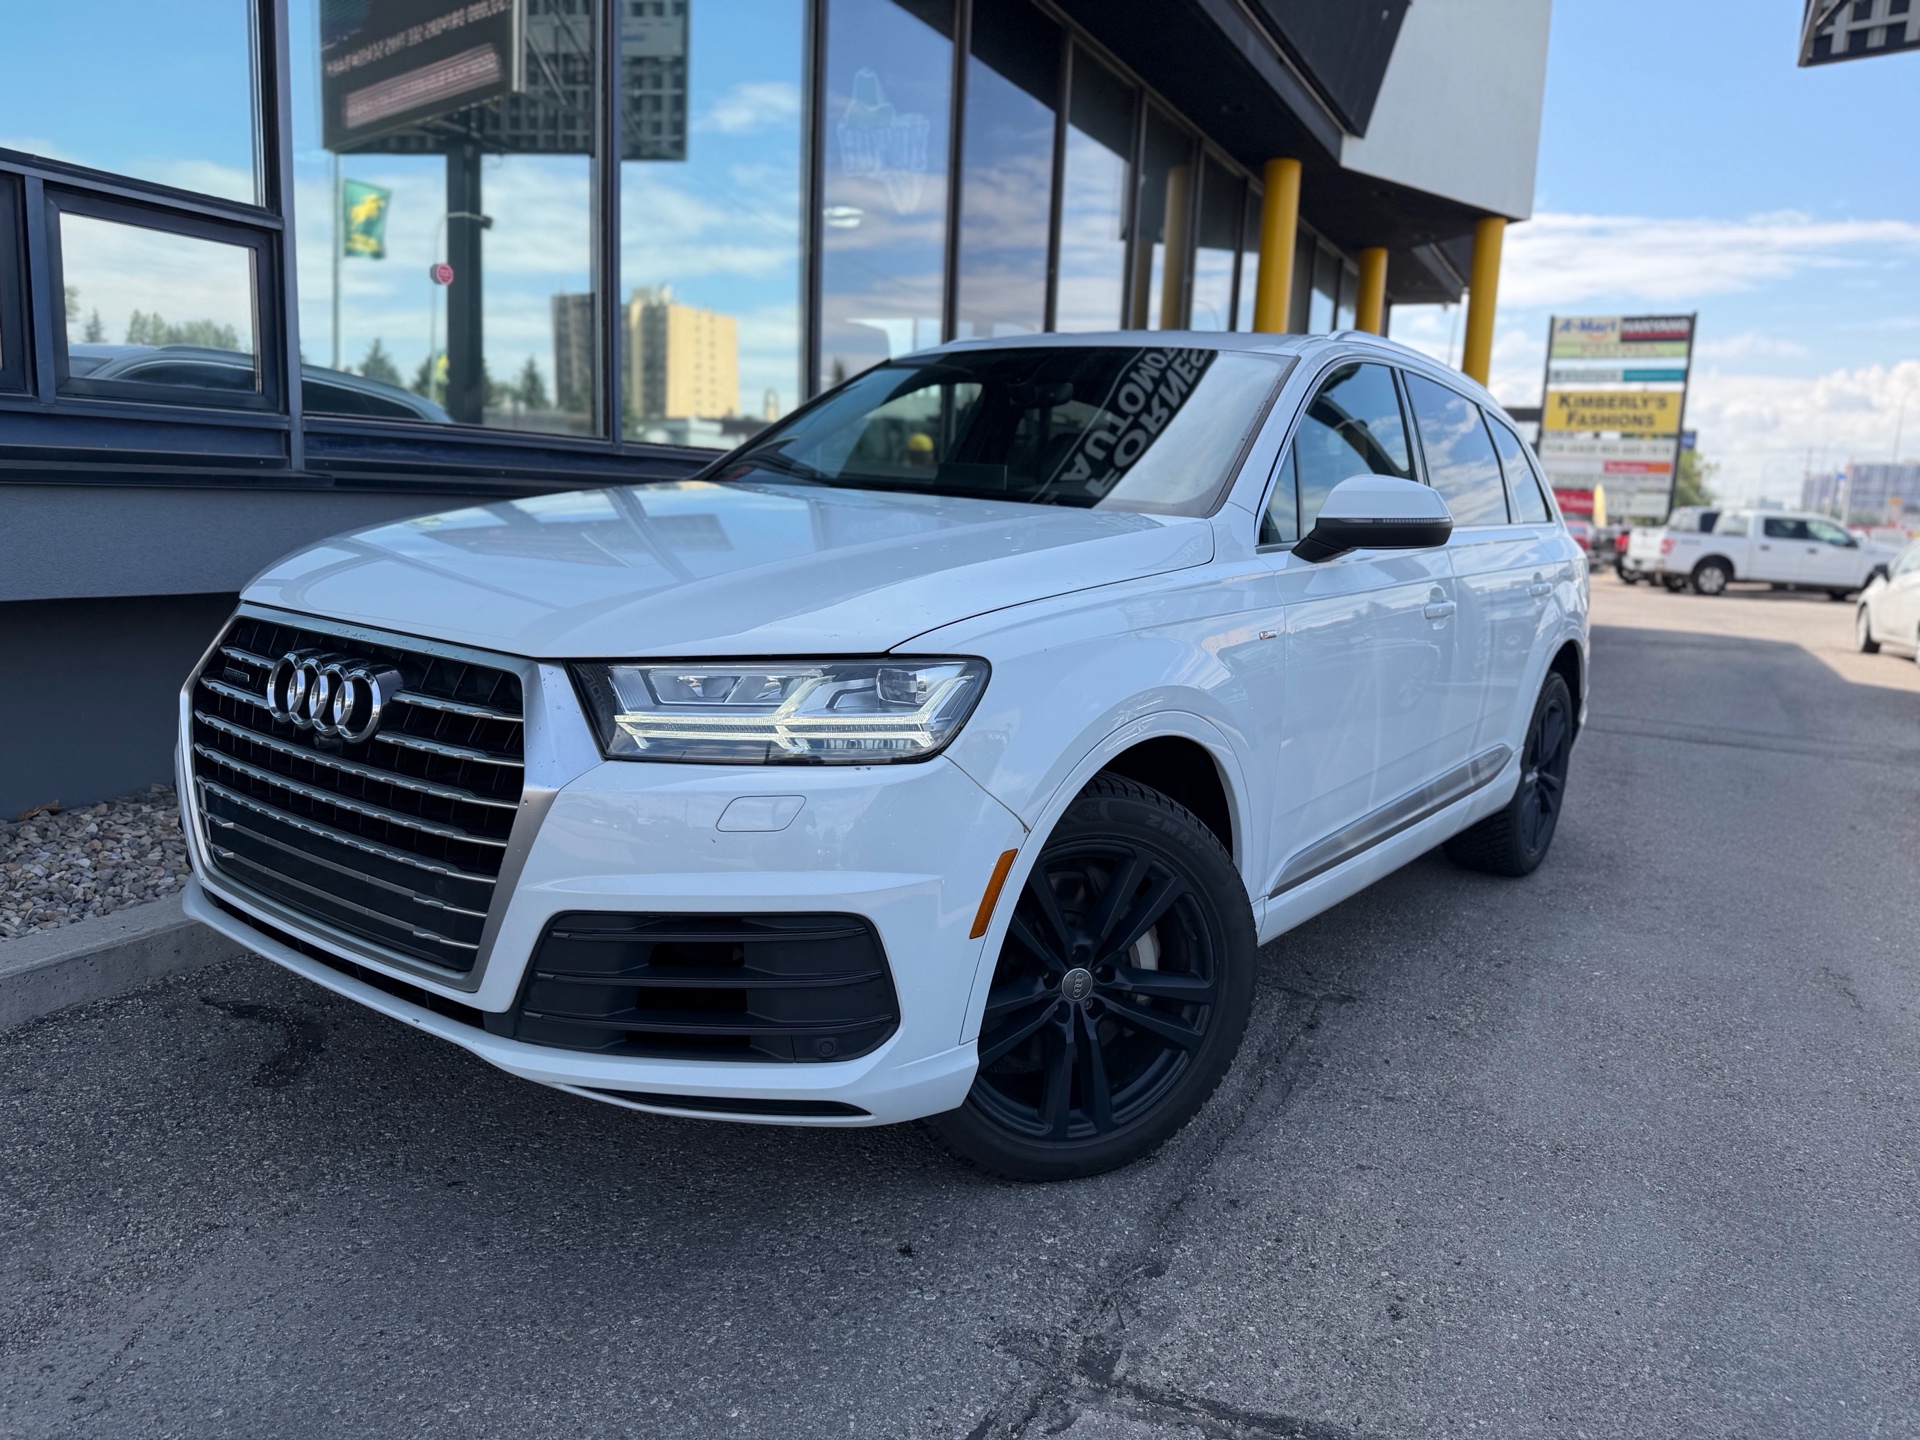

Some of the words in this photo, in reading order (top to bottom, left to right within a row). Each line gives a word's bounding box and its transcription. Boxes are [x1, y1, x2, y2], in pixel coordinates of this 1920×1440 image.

[1558, 394, 1668, 410] KIMBERLY'S
[1566, 412, 1655, 427] FASHIONS
[1145, 813, 1204, 855] ZMAX
